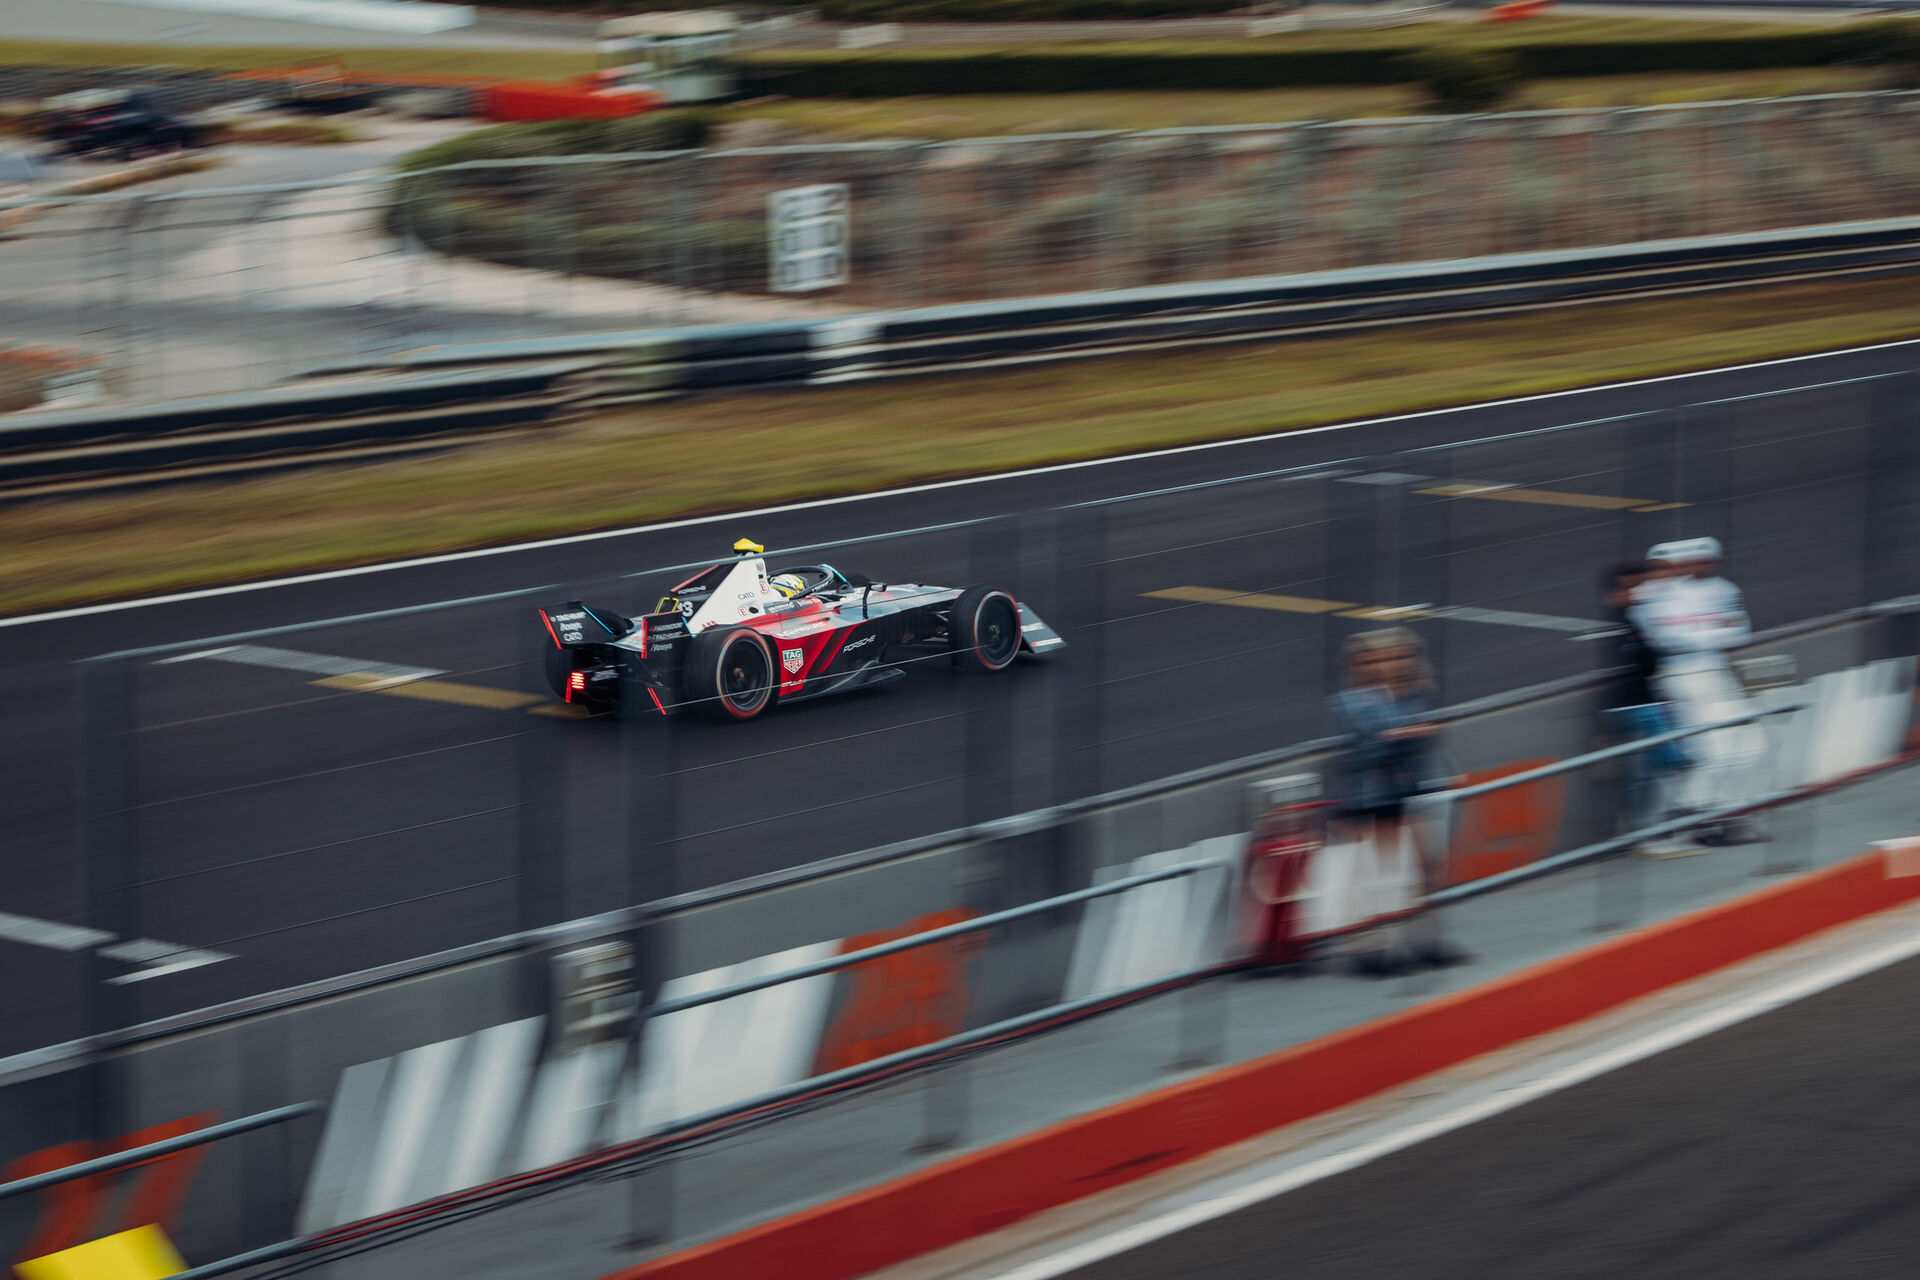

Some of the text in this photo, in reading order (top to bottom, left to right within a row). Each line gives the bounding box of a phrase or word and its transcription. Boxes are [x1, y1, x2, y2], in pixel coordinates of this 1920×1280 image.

[843, 634, 876, 653] PORSCHE
[784, 650, 801, 659] TAG
[784, 659, 803, 672] HEUER
